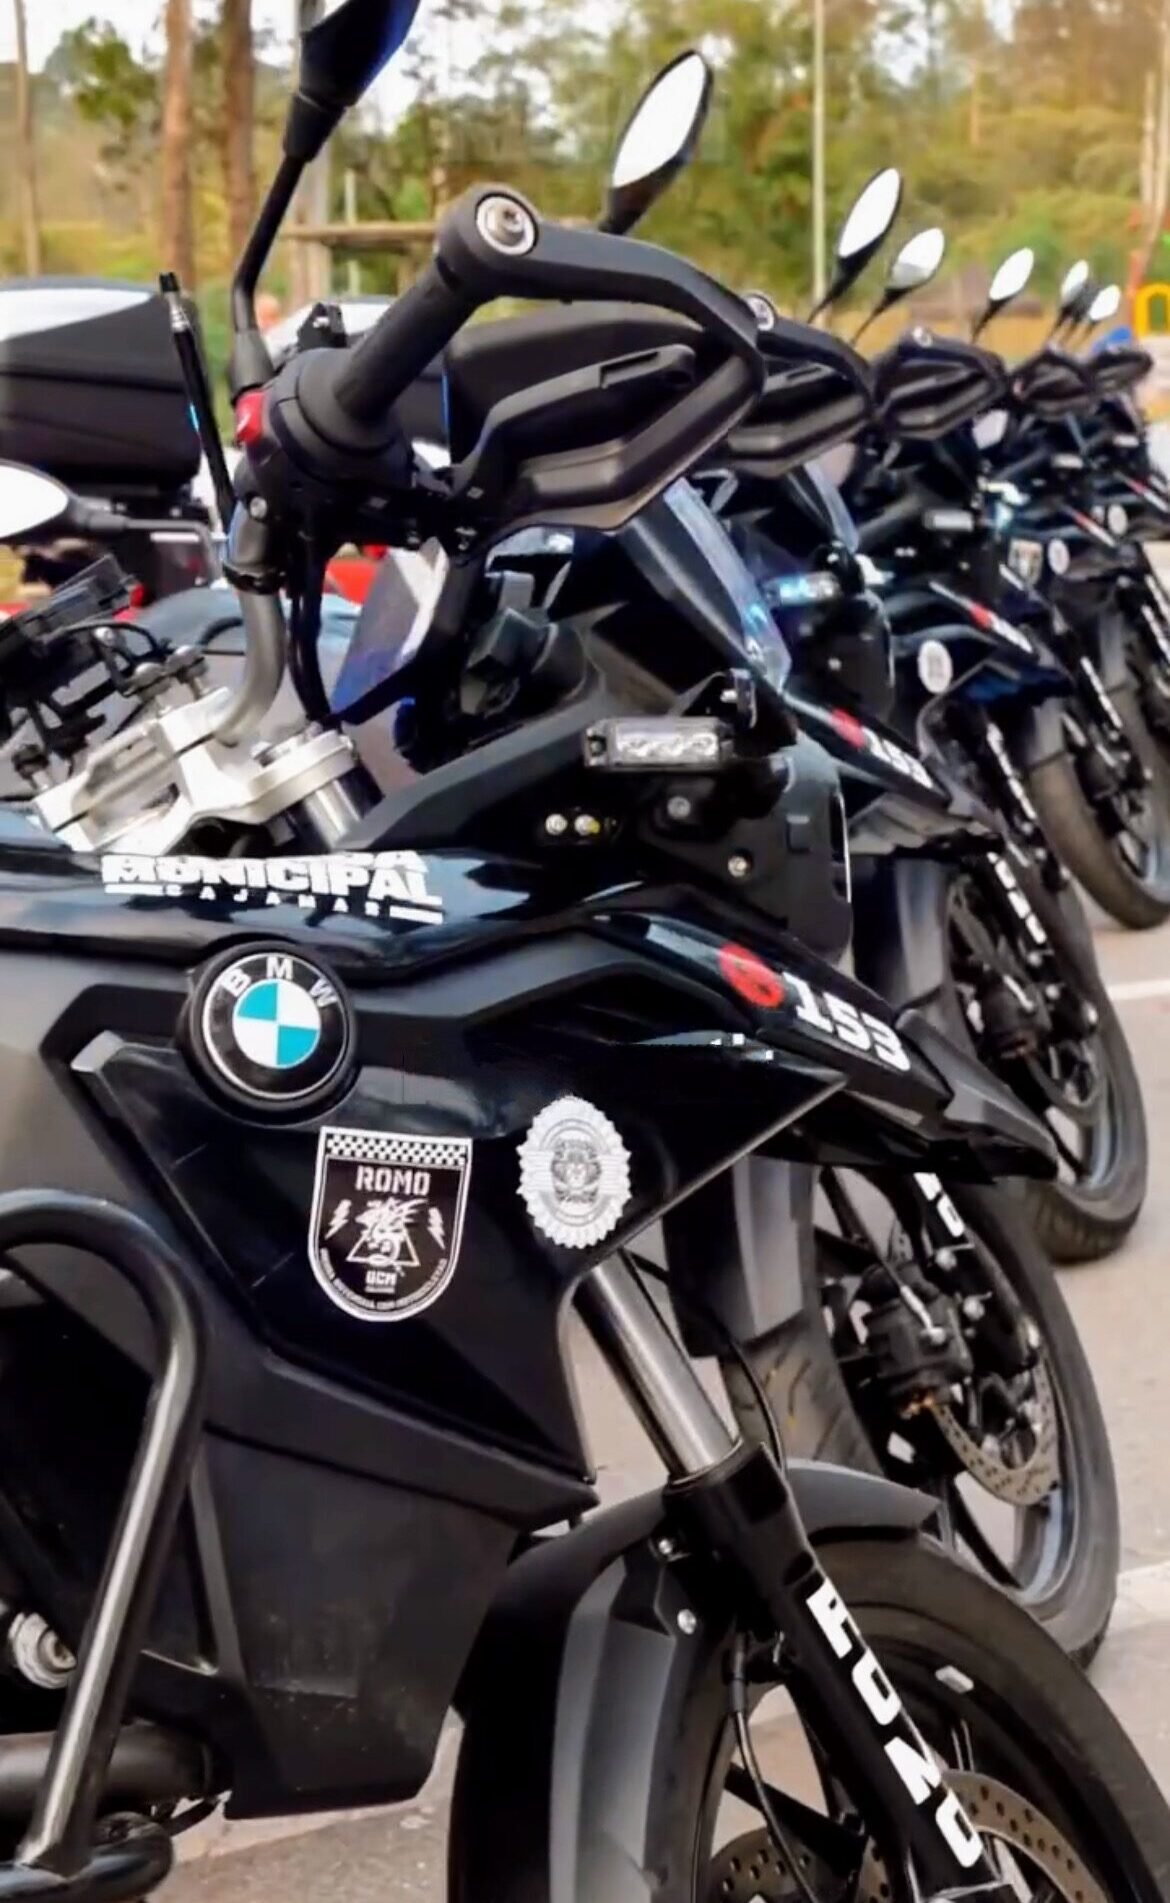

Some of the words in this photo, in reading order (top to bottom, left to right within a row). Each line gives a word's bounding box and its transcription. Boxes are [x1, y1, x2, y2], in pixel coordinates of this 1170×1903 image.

[218, 956, 339, 1009] BMW
[782, 971, 911, 1071] 153
[355, 1164, 431, 1196] ROMO
